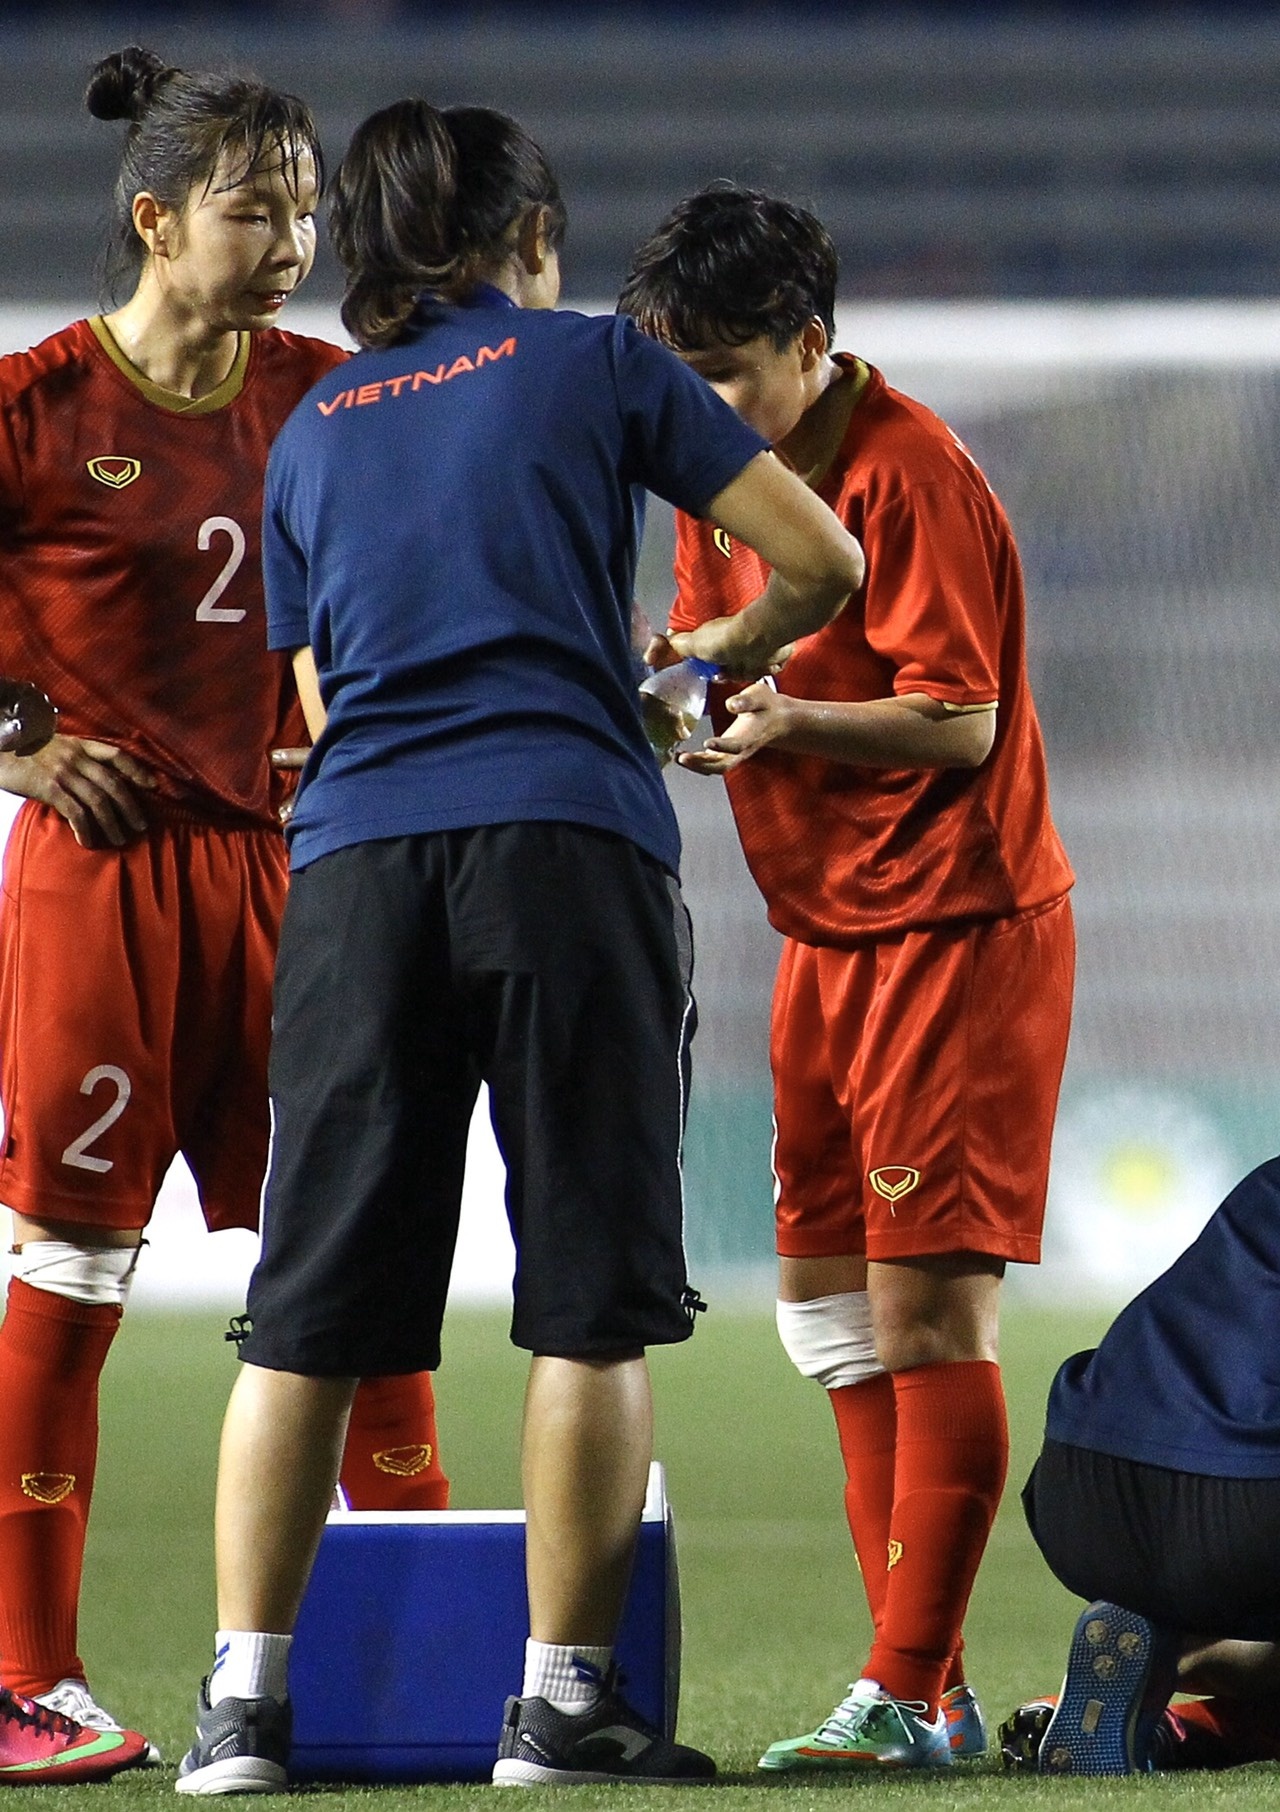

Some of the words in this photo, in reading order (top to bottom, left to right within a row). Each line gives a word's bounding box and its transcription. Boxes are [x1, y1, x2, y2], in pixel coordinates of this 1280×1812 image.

[317, 337, 517, 417] VIETNAM
[196, 516, 246, 622] 2
[61, 1064, 131, 1173] 2
